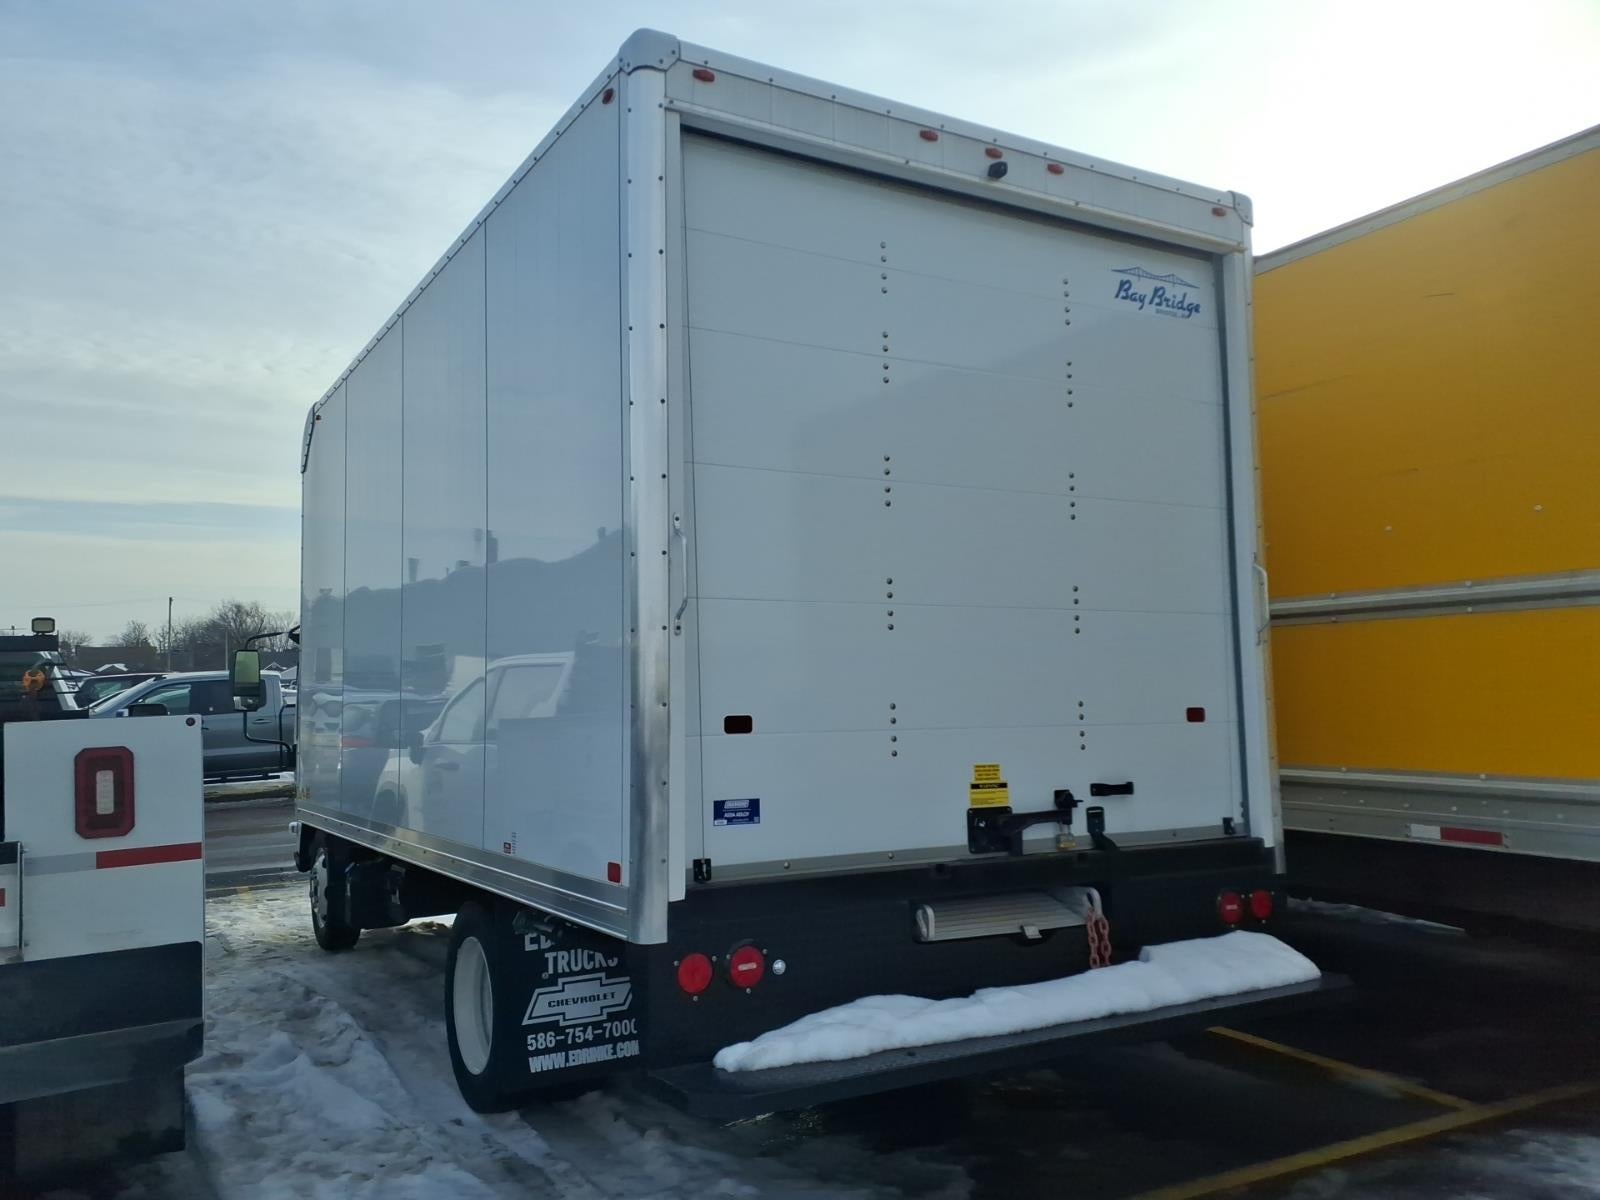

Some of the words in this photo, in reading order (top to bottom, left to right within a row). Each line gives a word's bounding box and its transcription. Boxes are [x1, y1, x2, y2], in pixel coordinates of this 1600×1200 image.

[1115, 280, 1147, 311] Bay
[1149, 286, 1200, 318] Bridge
[547, 991, 617, 1008] CHEVROLET
